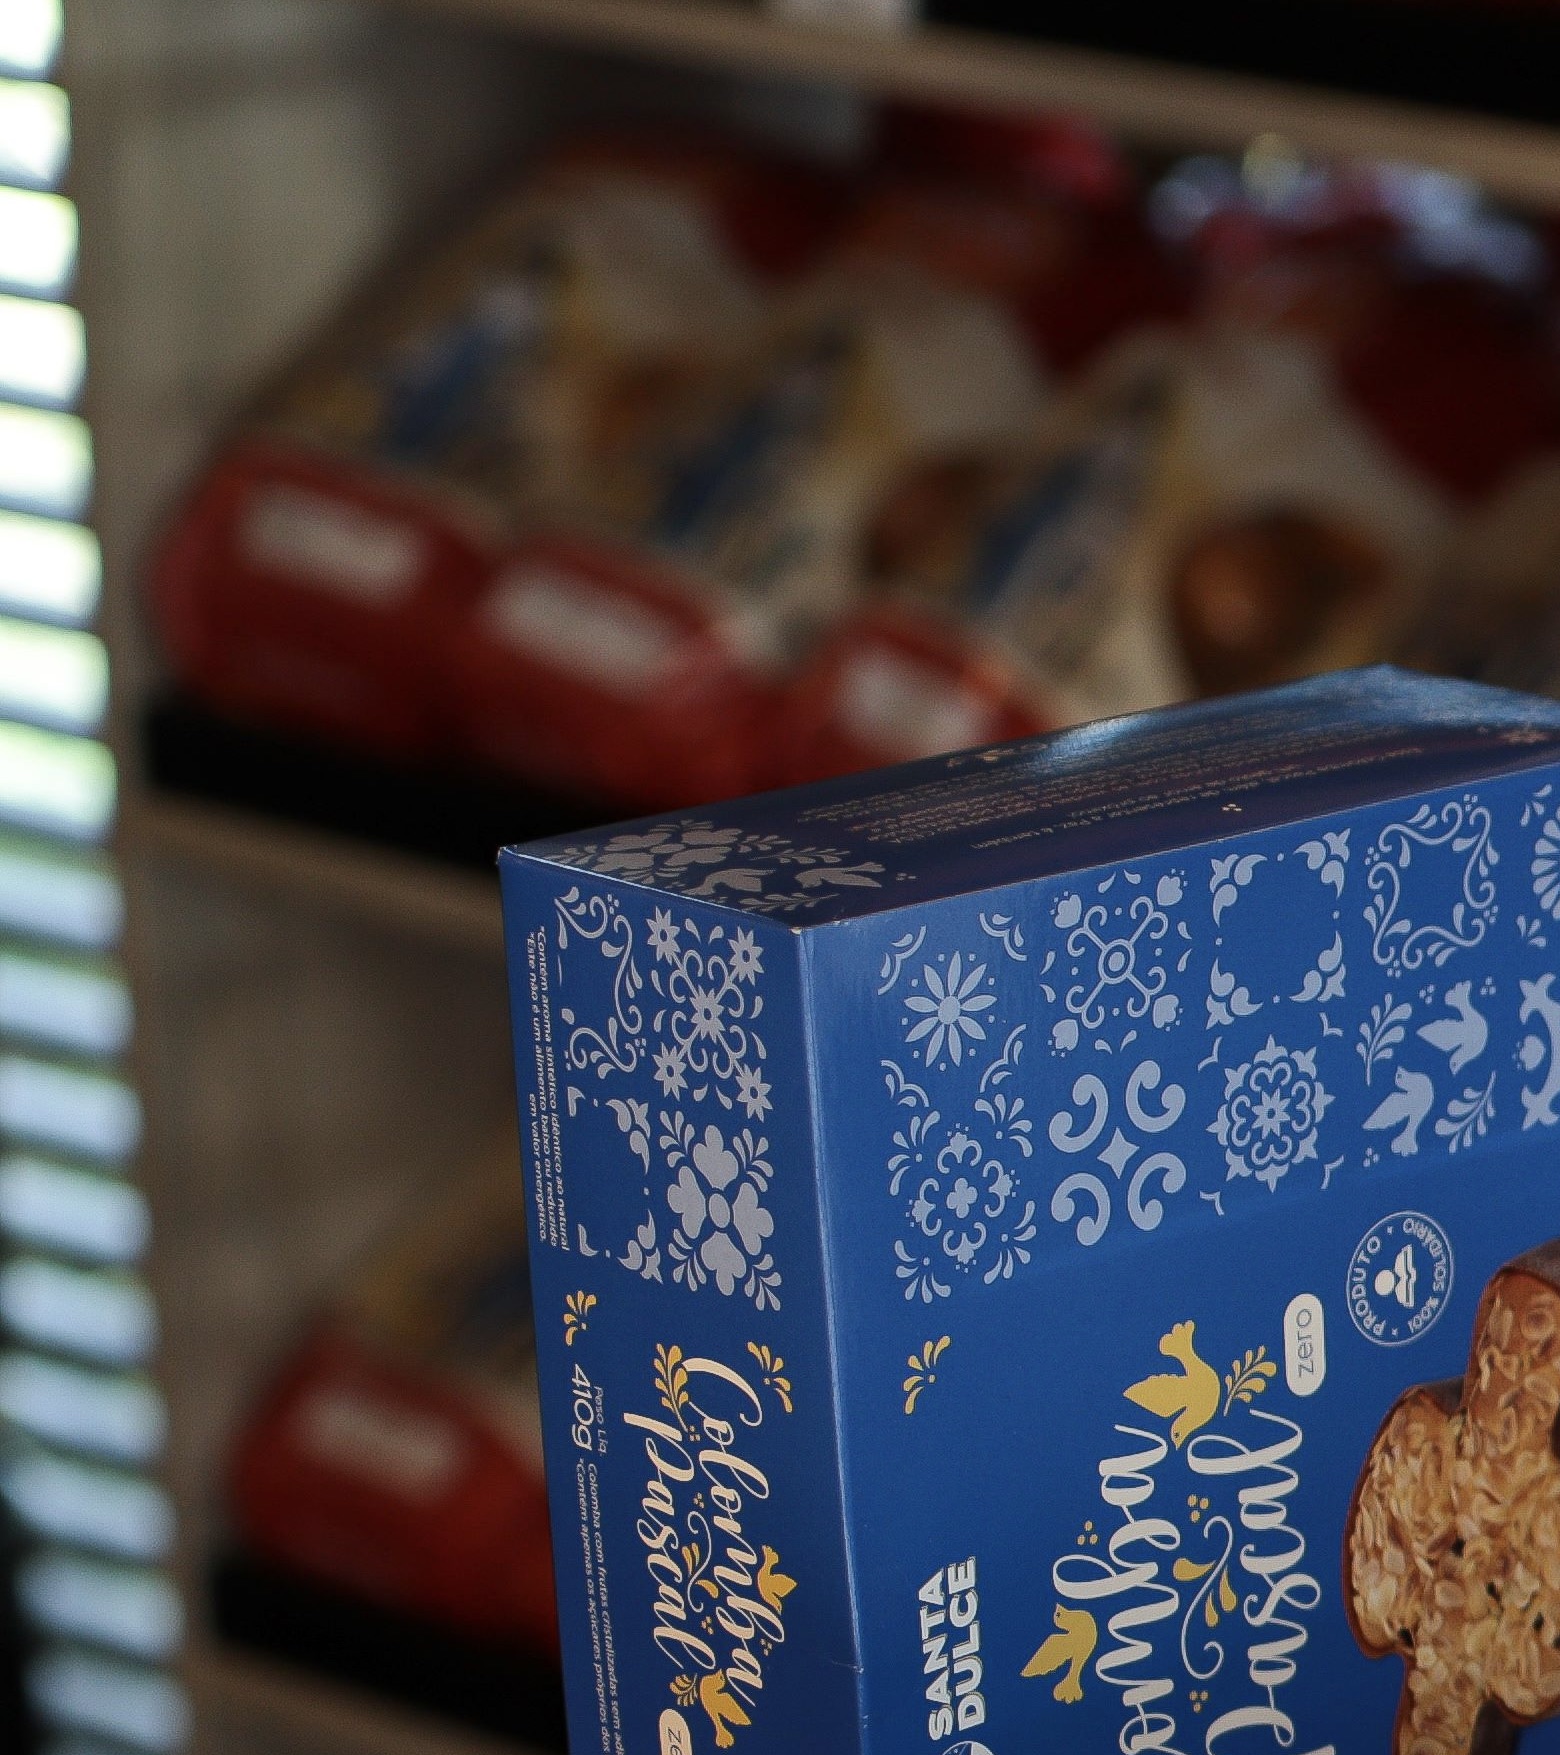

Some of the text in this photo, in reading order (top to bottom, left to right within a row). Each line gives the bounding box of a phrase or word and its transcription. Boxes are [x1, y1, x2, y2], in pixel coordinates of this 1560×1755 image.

[1296, 1309, 1314, 1377] zero
[1351, 1236, 1385, 1335] PRODUTO
[1403, 1219, 1445, 1334] 100% SOLIDÁRIO
[571, 1363, 592, 1451] 410g
[623, 1413, 716, 1669] Pascal
[682, 1357, 785, 1705] Colomba
[919, 1568, 954, 1741] SANTA
[953, 1557, 986, 1733] DULCE
